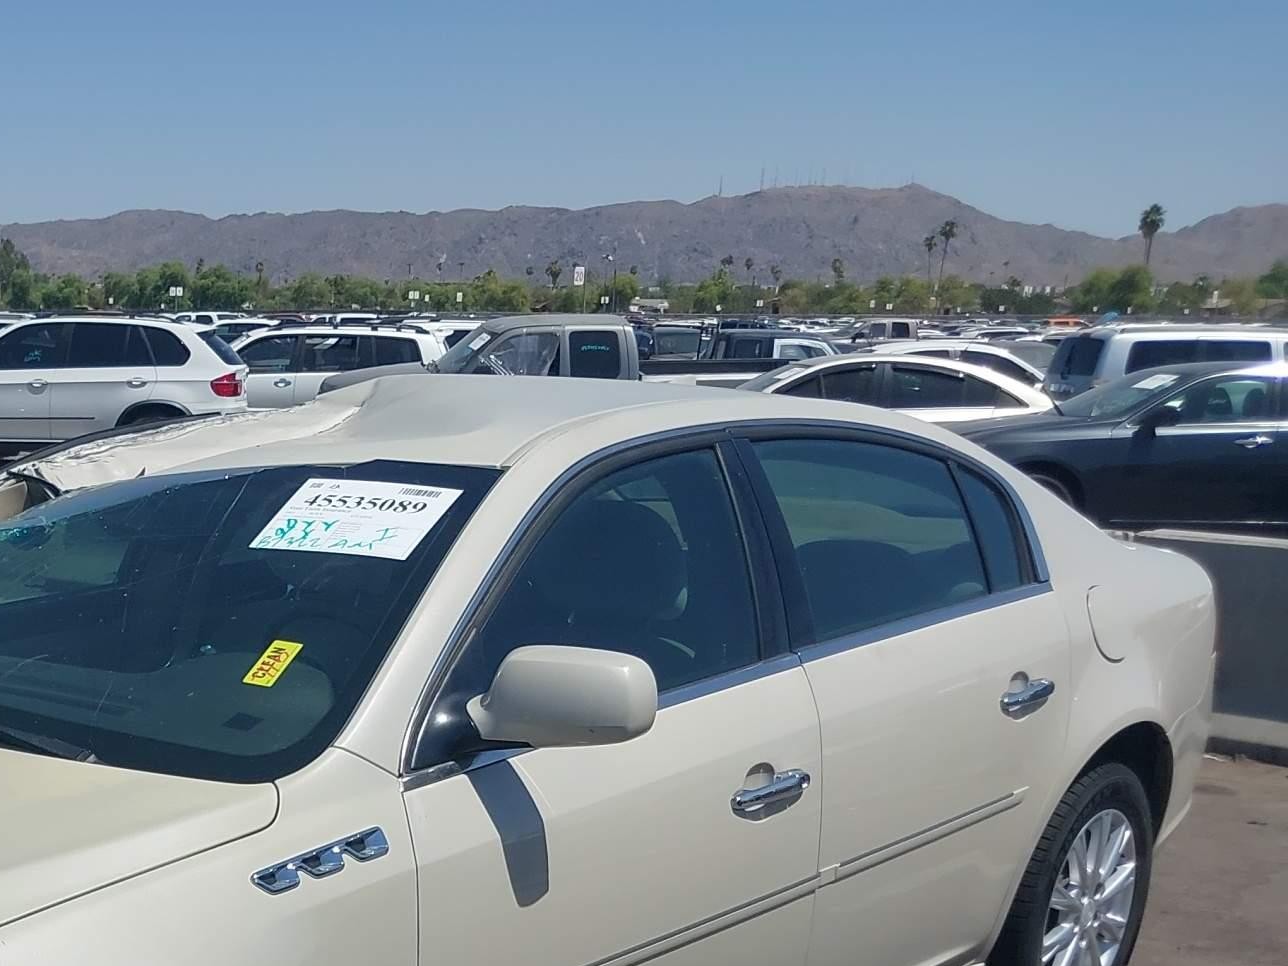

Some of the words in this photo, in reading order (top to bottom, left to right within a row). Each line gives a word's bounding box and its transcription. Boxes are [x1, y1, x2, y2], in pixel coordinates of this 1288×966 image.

[574, 271, 584, 282] 20
[304, 494, 428, 514] 45535089
[251, 646, 287, 679] CLEAN
